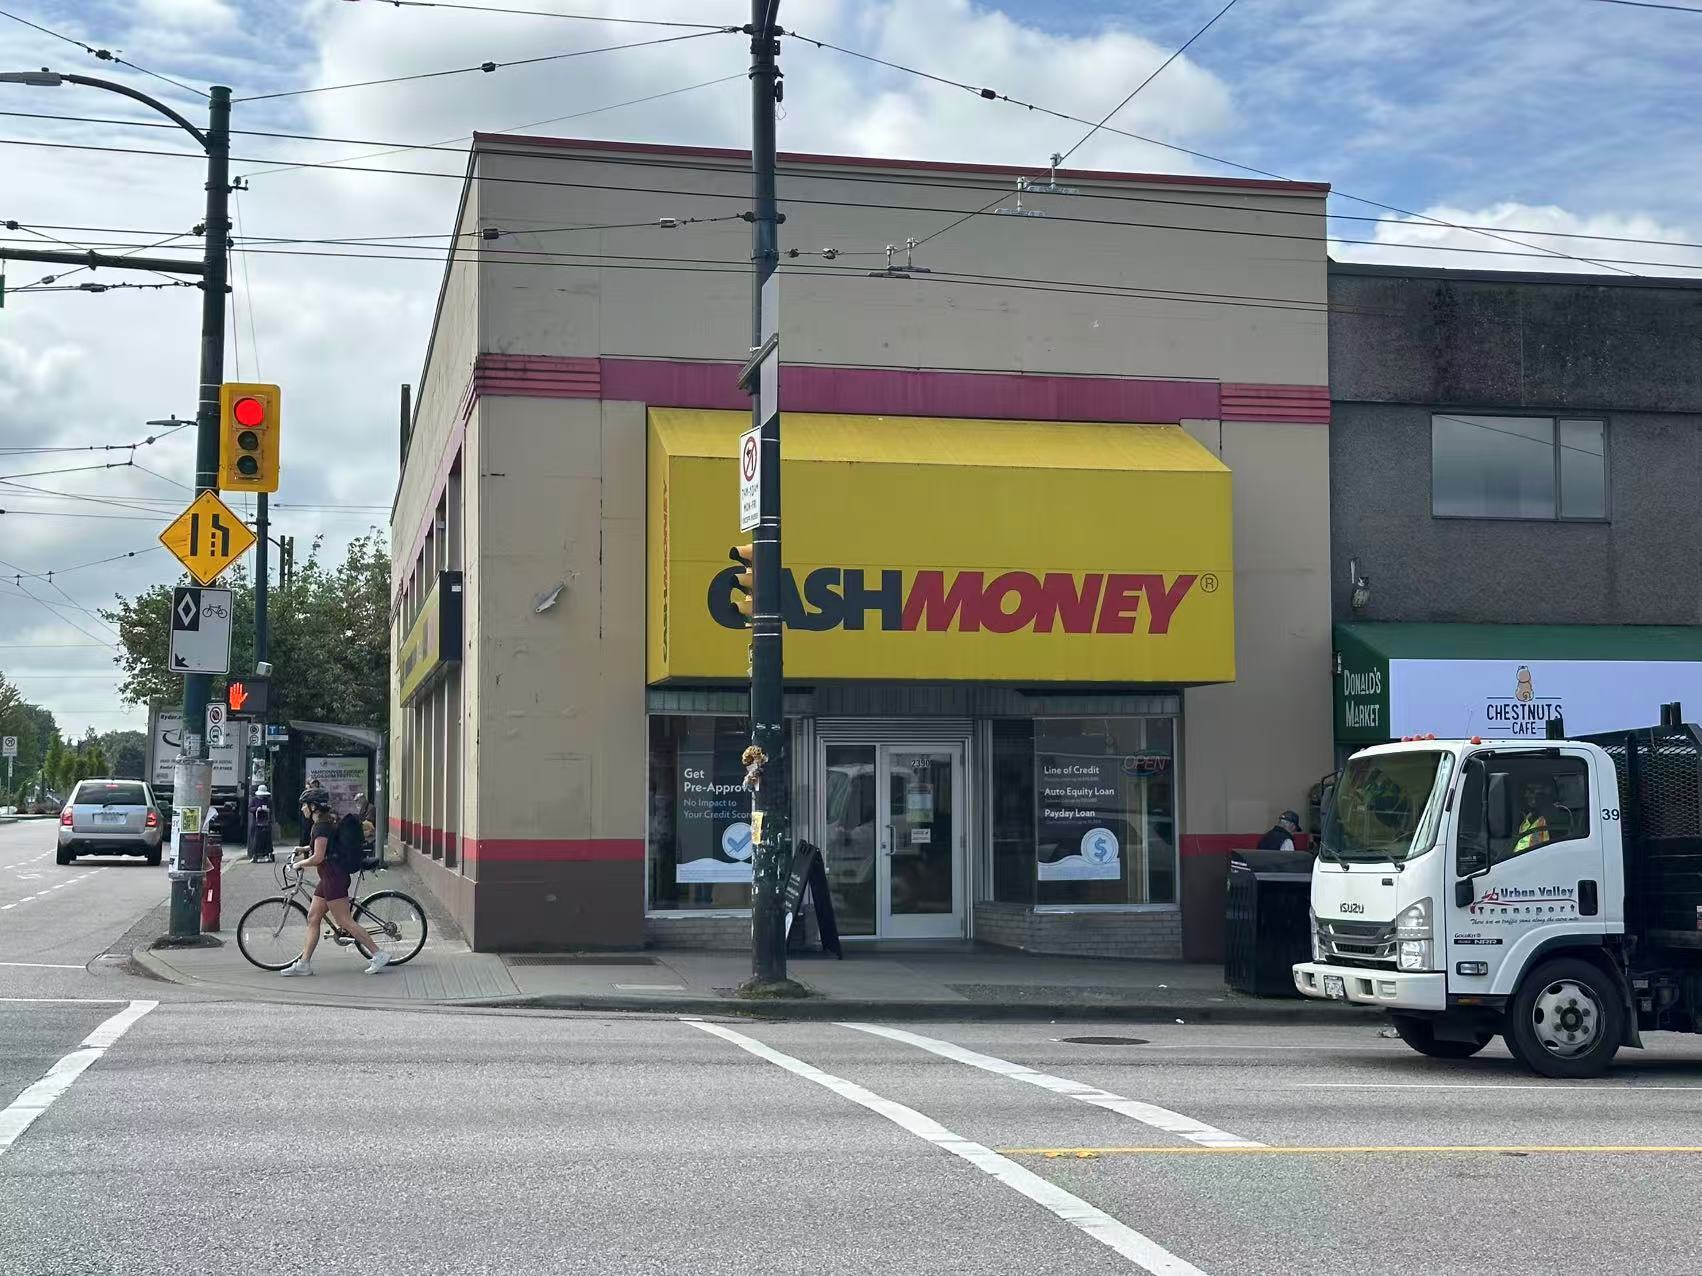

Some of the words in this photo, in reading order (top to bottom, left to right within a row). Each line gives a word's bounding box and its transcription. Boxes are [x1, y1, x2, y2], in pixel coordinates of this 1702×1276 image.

[1344, 667, 1381, 696] DONALD'S
[1345, 700, 1380, 727] MARKET
[1487, 704, 1563, 721] CHESTNUTS
[1512, 721, 1536, 734] CAFE
[1123, 755, 1166, 770] OPEN
[684, 768, 705, 779] Get
[1044, 765, 1062, 774] Line
[1063, 765, 1072, 774] of
[1073, 765, 1100, 774] Credit
[1044, 788, 1066, 796] Auto
[1066, 787, 1093, 797] Equity
[1094, 787, 1115, 796] Loan
[683, 799, 697, 807] No
[698, 799, 726, 808] Impact
[728, 799, 737, 807] to
[683, 810, 702, 819] Your
[703, 810, 730, 819] Credit
[731, 810, 753, 819] Scor
[1044, 809, 1074, 819] Payday
[1075, 808, 1096, 817] Loan
[1602, 808, 1620, 821] 39
[1500, 887, 1535, 897] Urban
[1538, 886, 1574, 898] Valley
[1340, 903, 1365, 914] ISUZU
[1478, 904, 1576, 915] Transport
